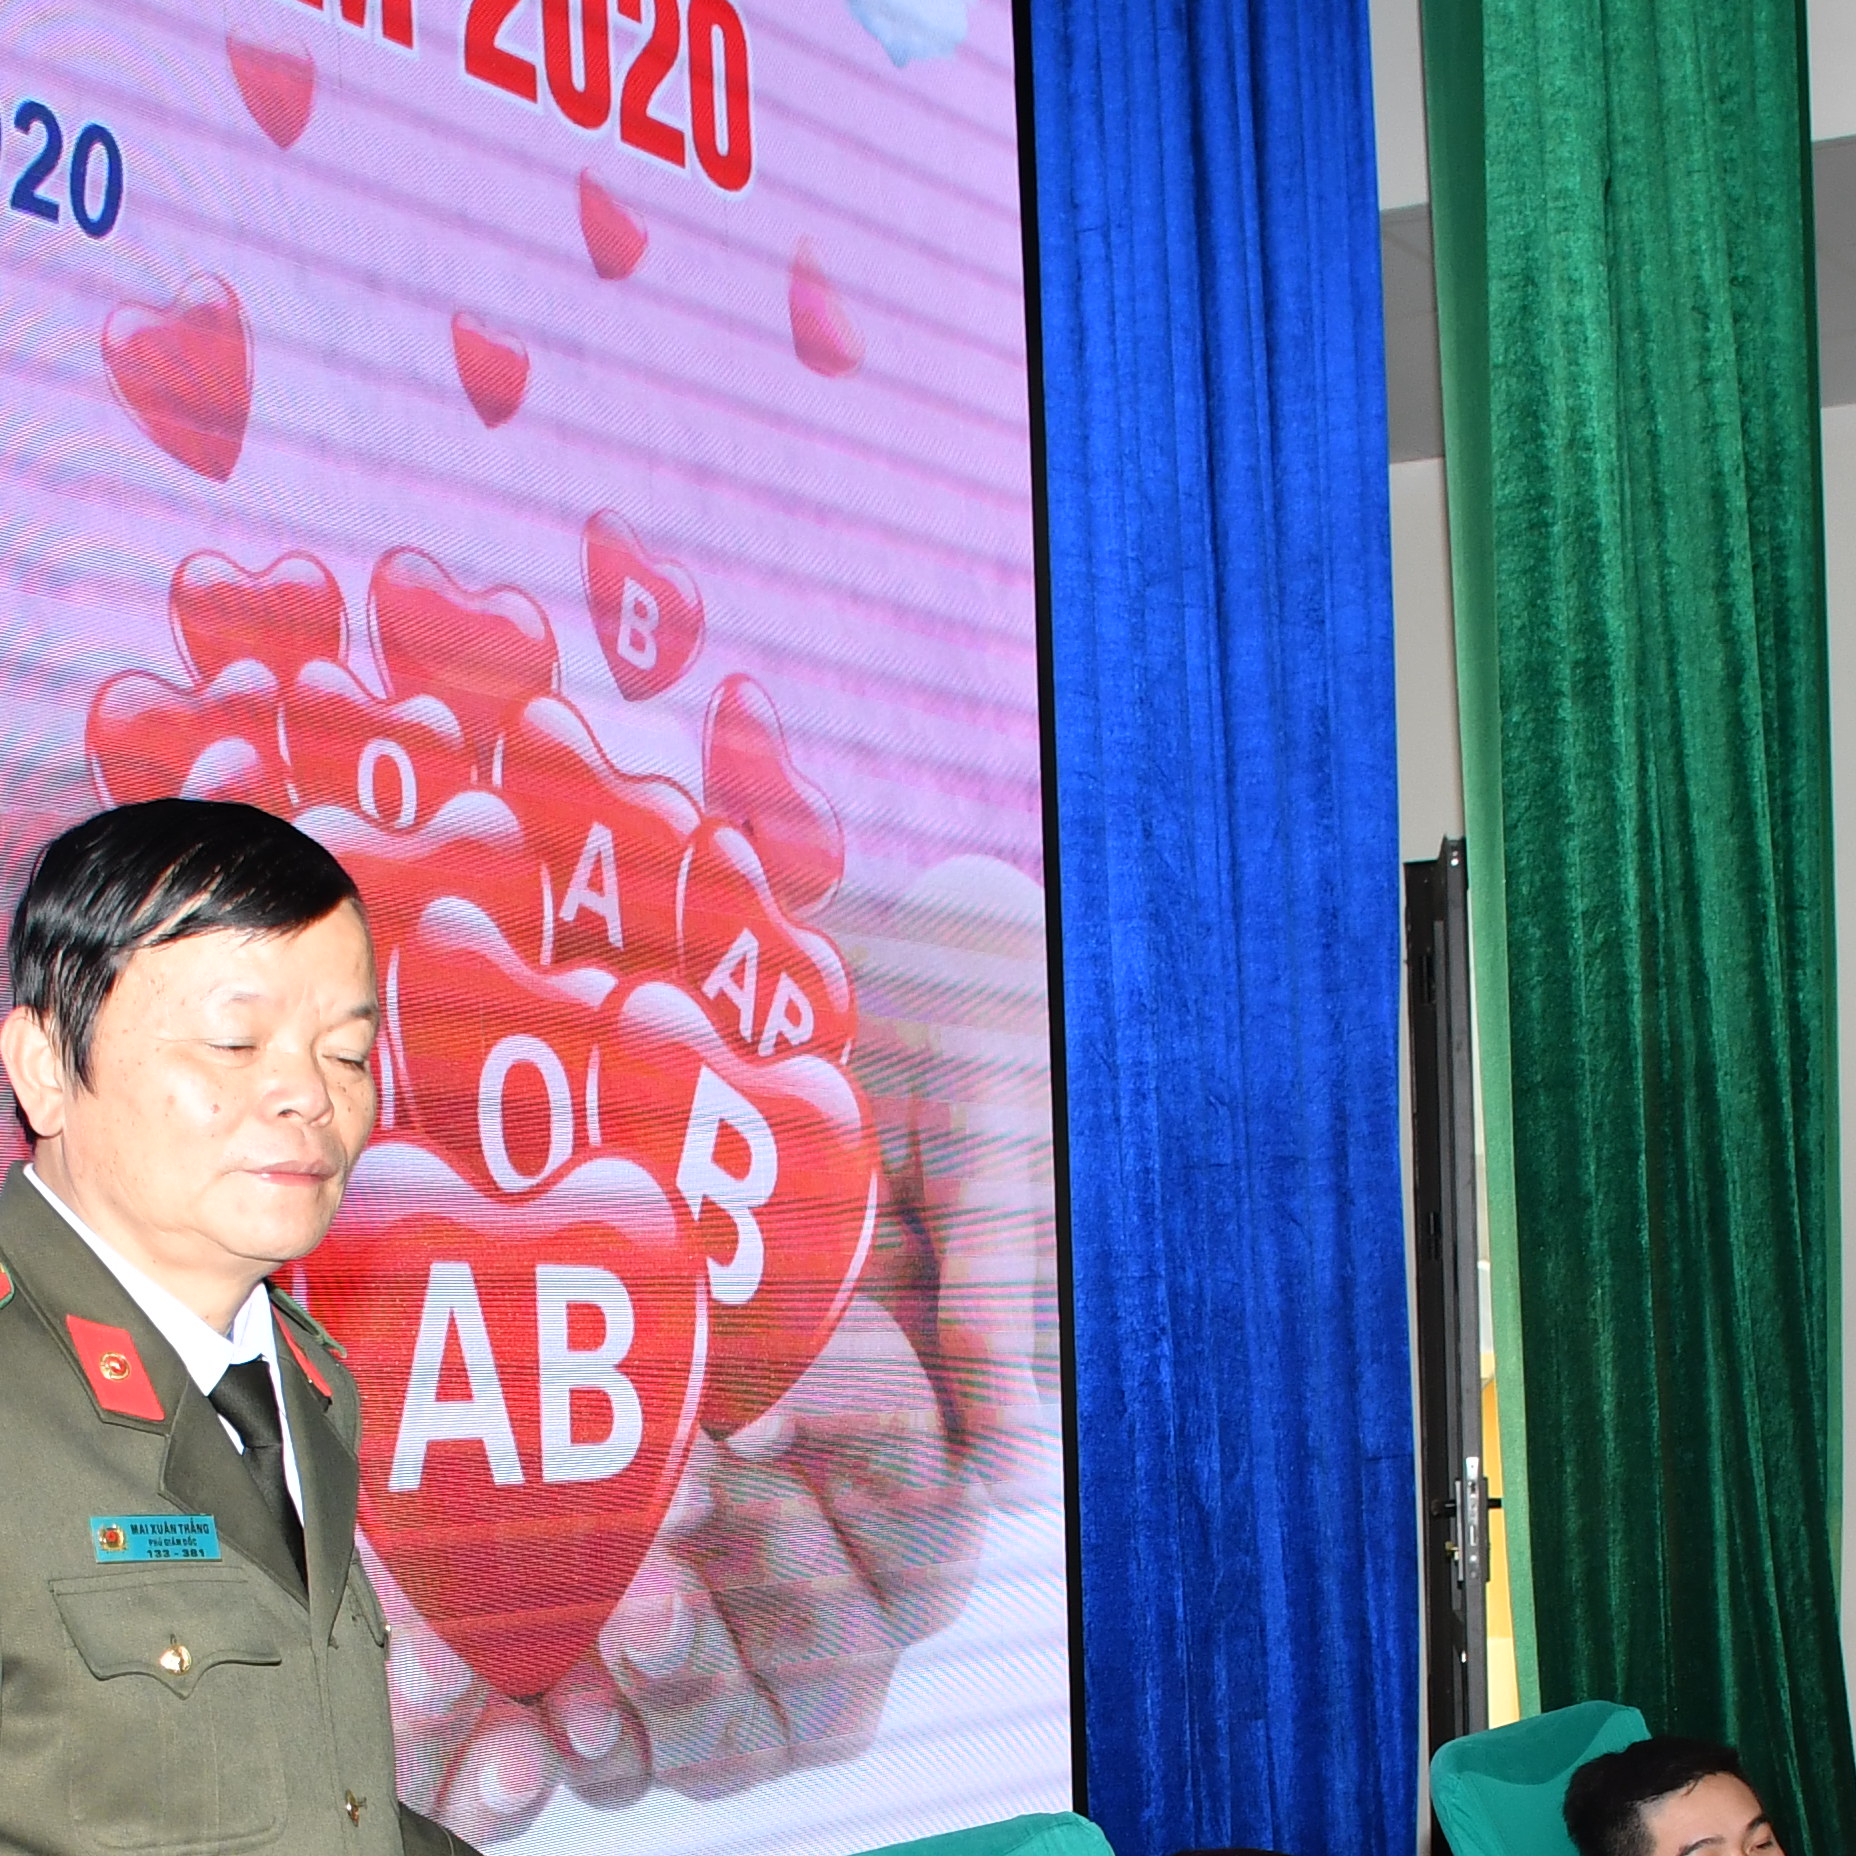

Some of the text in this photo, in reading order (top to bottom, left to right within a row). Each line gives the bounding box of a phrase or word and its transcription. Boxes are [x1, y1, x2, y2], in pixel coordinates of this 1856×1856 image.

[616, 576, 659, 672] B
[560, 824, 623, 944] A
[477, 1033, 574, 1193] O
[676, 1065, 779, 1304] B
[388, 1261, 643, 1493] AB
